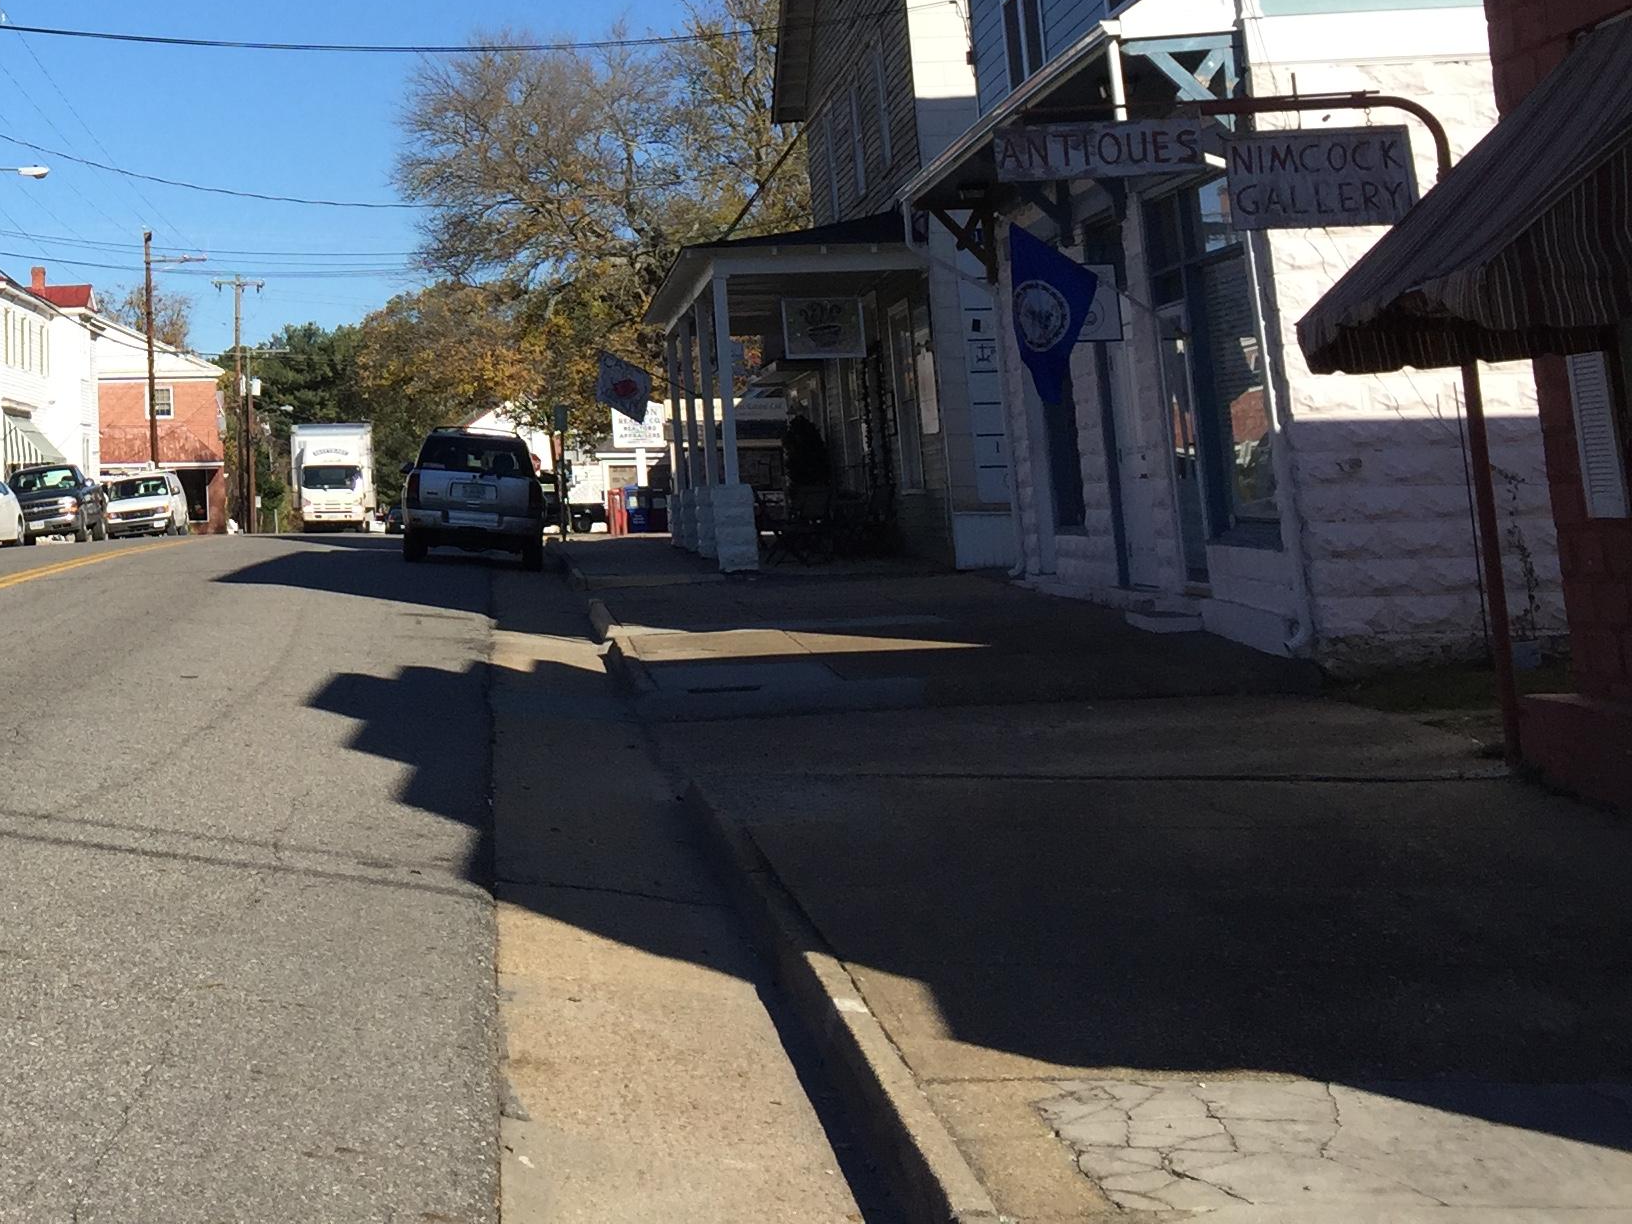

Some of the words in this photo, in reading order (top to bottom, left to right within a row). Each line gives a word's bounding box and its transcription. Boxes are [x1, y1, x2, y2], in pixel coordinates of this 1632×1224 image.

[1000, 130, 1198, 169] ANTIQUES
[1230, 140, 1404, 175] NIMCOCK
[1236, 181, 1404, 216] GALLERY
